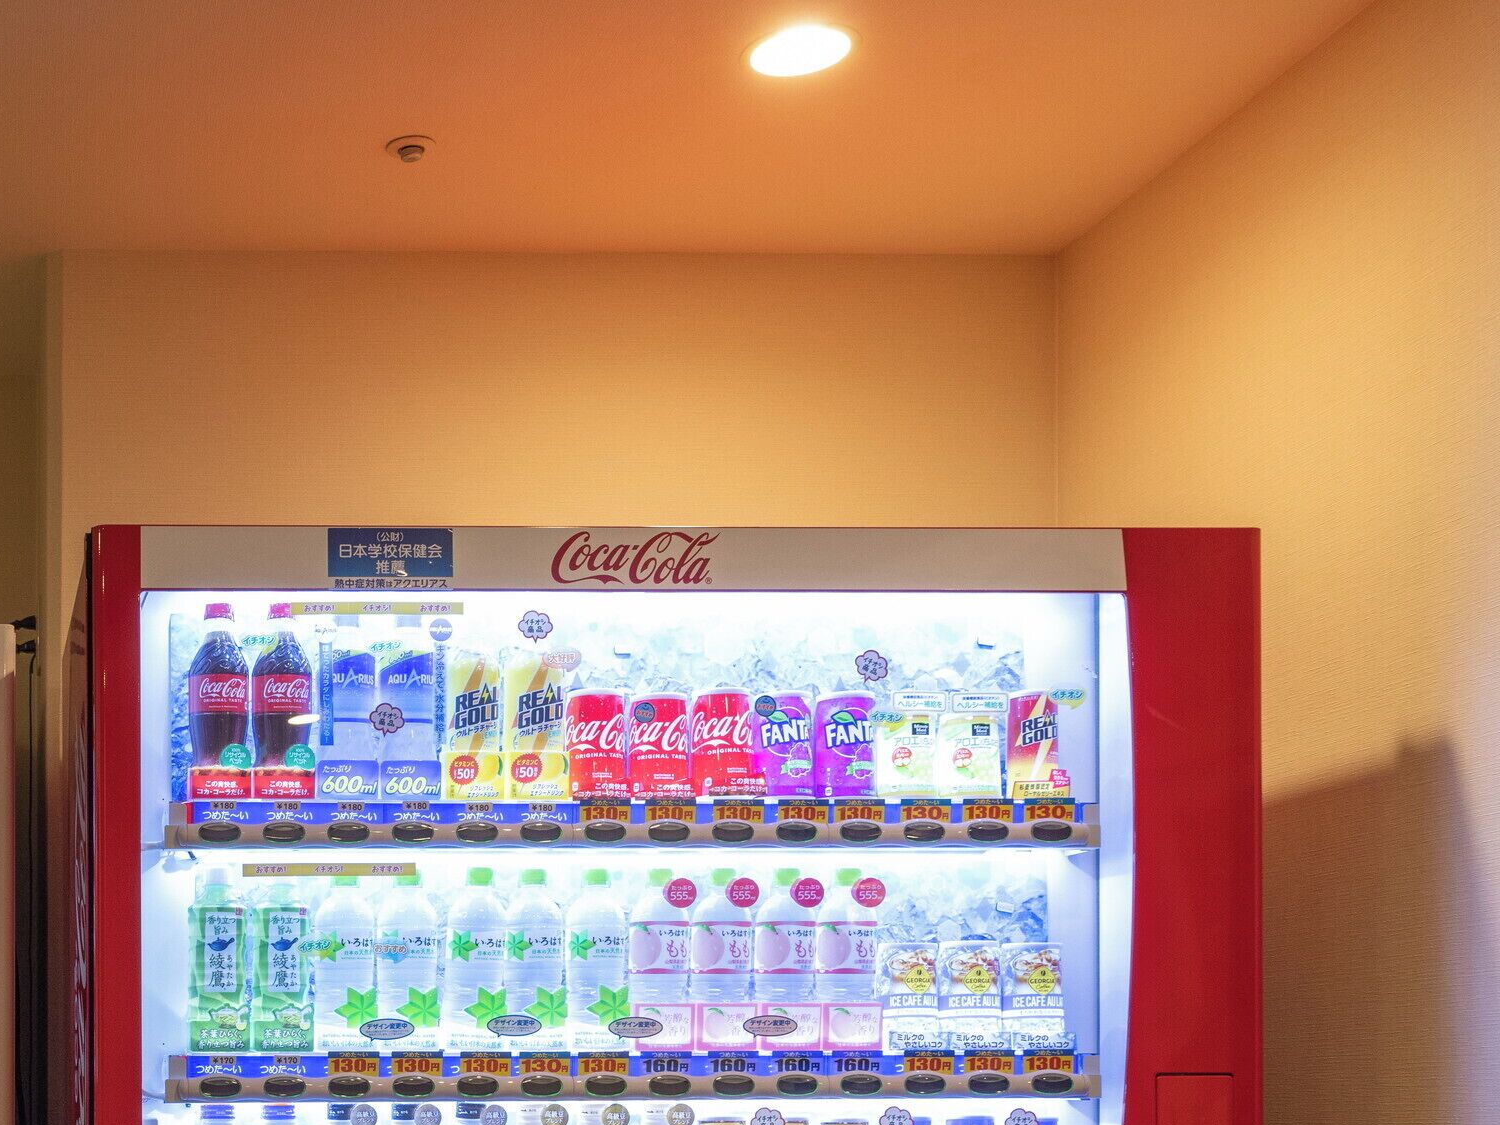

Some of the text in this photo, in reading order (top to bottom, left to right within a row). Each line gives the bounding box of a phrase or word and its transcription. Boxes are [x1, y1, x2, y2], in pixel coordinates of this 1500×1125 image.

[339, 544, 442, 558] 日本学校保健会
[551, 531, 721, 584] Coca-Cola
[334, 578, 448, 589] 熱中症対策はアクエリアス
[200, 678, 246, 699] Coca-Cola
[264, 678, 310, 699] Coca-Cola
[518, 683, 563, 714] REAL
[323, 766, 351, 774] たっぷり
[386, 766, 415, 774] たっぷり
[322, 775, 377, 795] 600ml
[386, 776, 440, 795] 600ml
[582, 806, 628, 820] 130円
[646, 806, 693, 820] 130円
[716, 806, 761, 820] 130円
[780, 807, 826, 820] 130円
[902, 806, 948, 821] 130円
[1027, 806, 1072, 820] 130円
[207, 916, 236, 925] 香り立つ
[270, 916, 299, 925] 香り立つ
[213, 926, 229, 935] 旨み
[277, 926, 293, 935] 旨み
[209, 953, 225, 990] 綾鷹
[273, 953, 289, 990] 綾鷹
[643, 1059, 689, 1072] 160円
[711, 1059, 755, 1072] 160円
[835, 1059, 879, 1072] 160円
